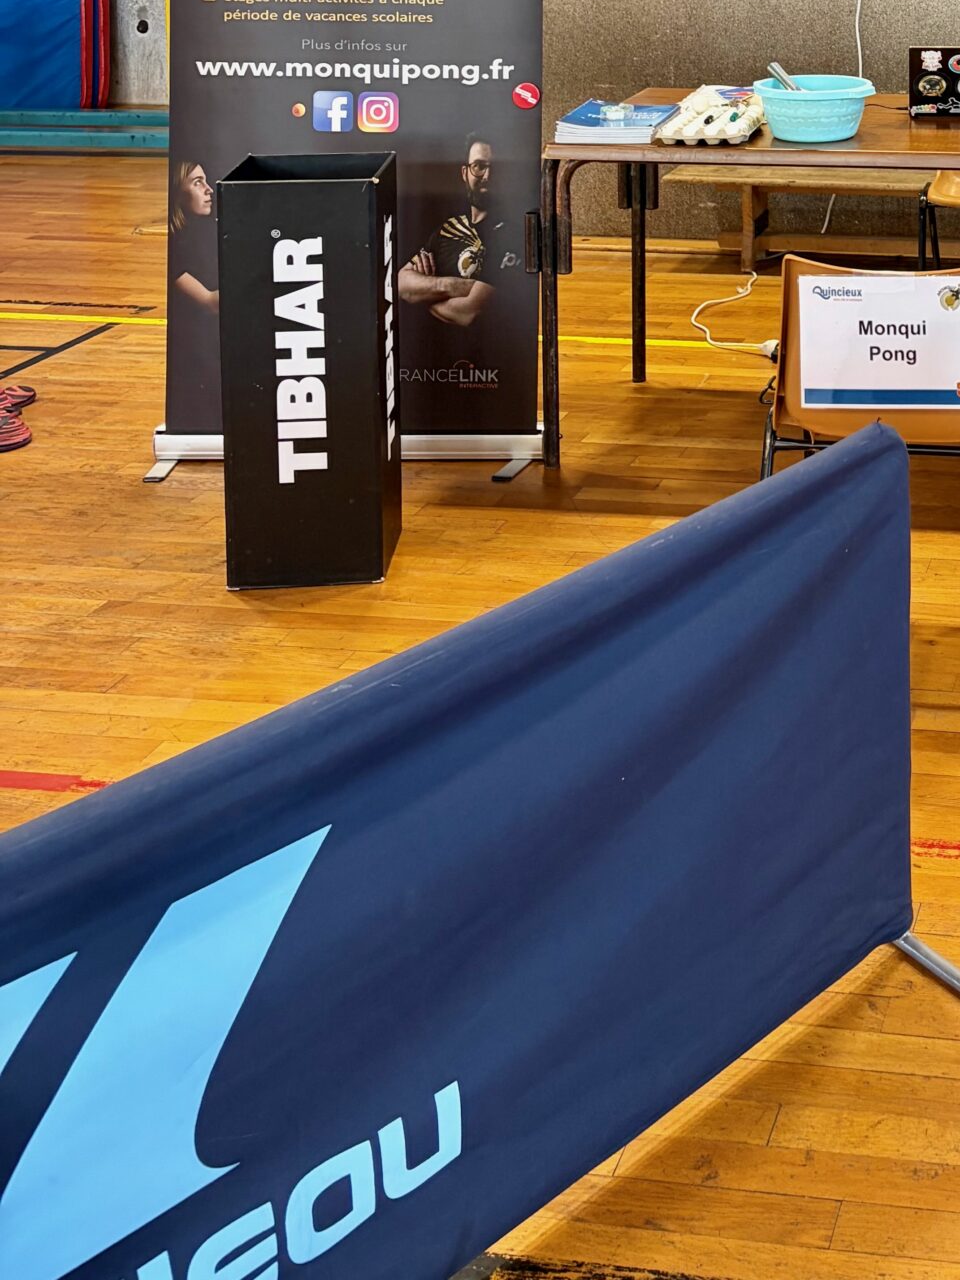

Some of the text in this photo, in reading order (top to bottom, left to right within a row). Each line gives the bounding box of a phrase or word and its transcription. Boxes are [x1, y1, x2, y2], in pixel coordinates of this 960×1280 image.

[224, 10, 433, 23] période de vacances scolaires
[301, 39, 408, 51] Plus d'infos sur
[196, 58, 515, 85] www.monquipong.fr
[812, 285, 863, 300] Quincieux
[858, 320, 927, 339] Monqui
[272, 236, 329, 484] TIBHAR
[869, 346, 917, 365] Pong
[400, 363, 499, 382] RANCELINK
